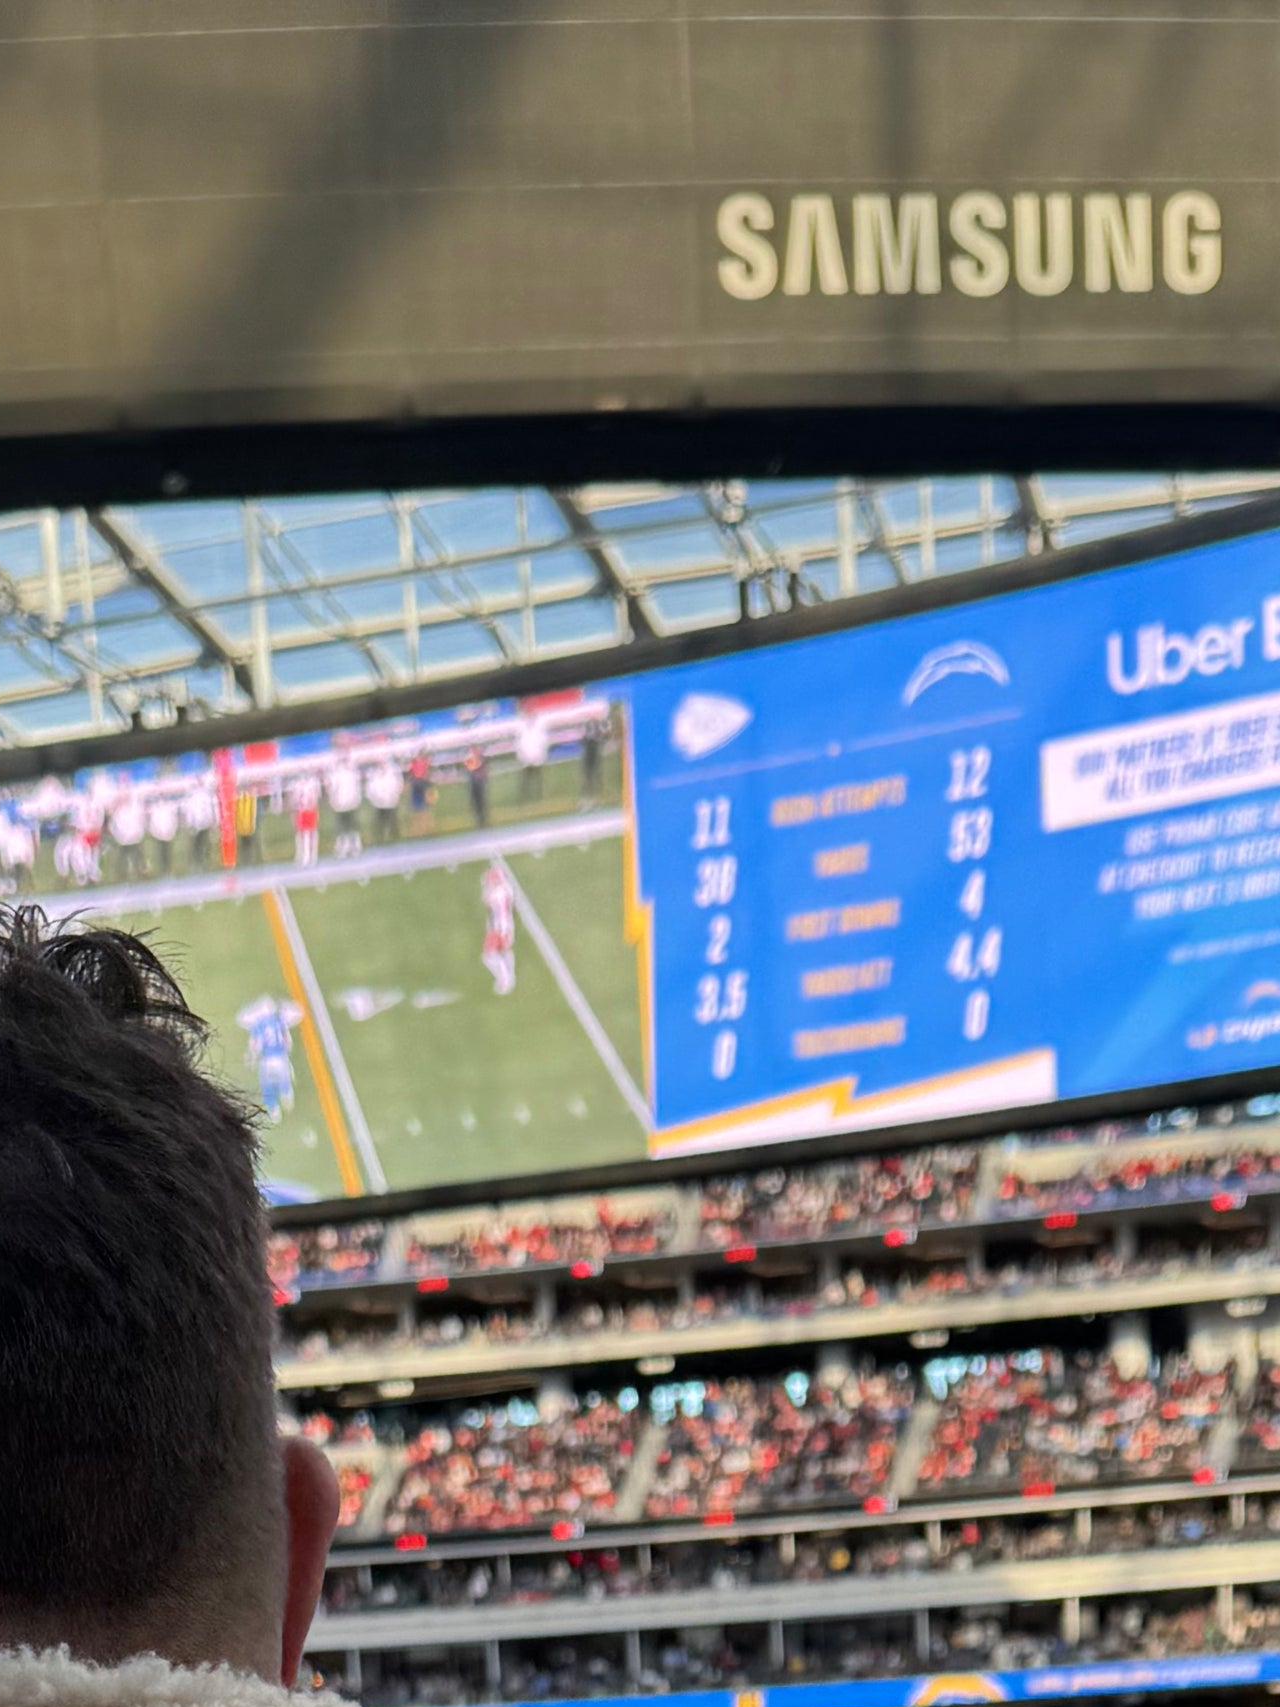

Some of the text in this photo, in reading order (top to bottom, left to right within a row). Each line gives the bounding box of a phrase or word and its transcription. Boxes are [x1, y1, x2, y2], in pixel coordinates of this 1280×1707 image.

[716, 190, 1222, 301] SAMSUNG
[1106, 619, 1252, 694] Uber
[691, 796, 731, 851] 11
[945, 745, 992, 803] 12
[705, 913, 731, 966] 2
[959, 867, 986, 921] 4
[945, 925, 1003, 983] 4.4
[712, 1029, 737, 1081] 0
[963, 987, 990, 1041] 0
